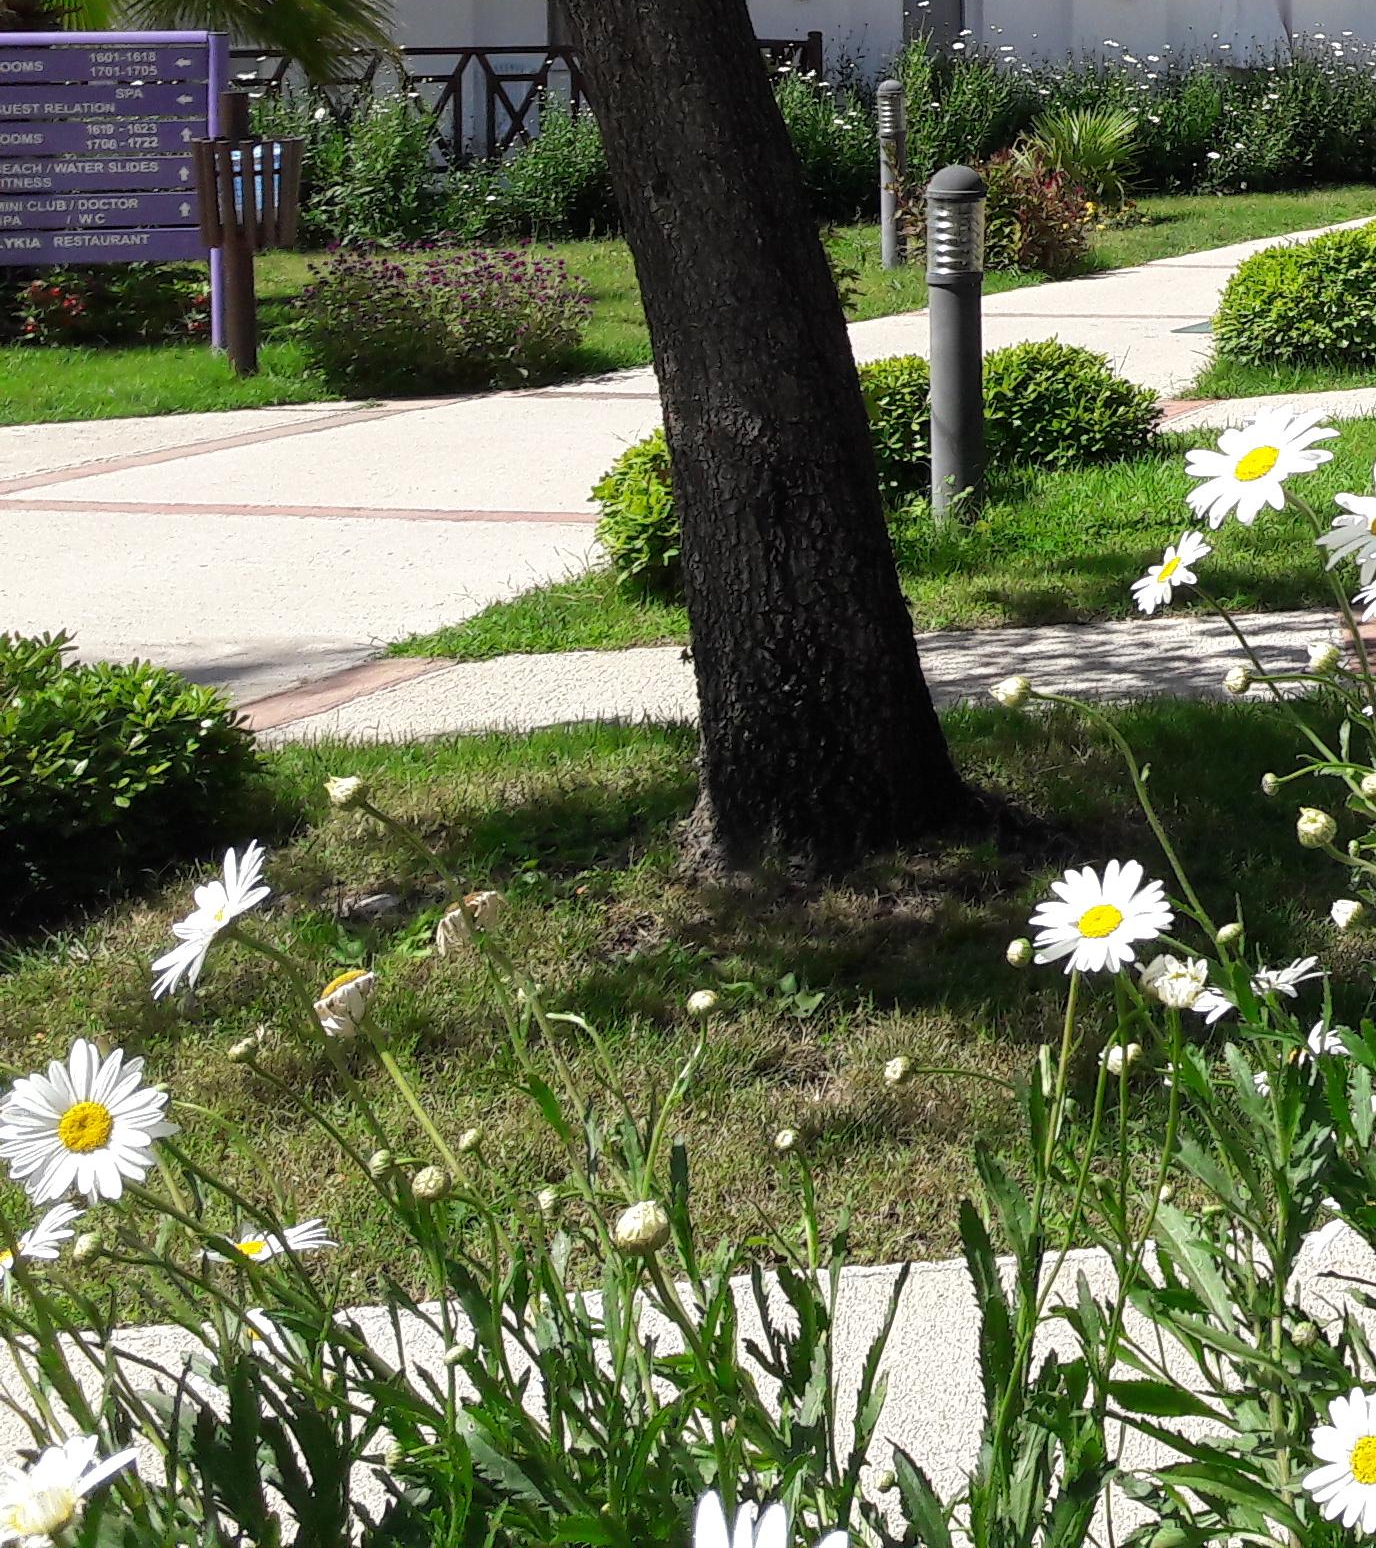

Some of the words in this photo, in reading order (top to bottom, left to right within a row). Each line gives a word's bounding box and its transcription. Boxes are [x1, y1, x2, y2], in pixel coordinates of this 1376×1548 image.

[0, 61, 44, 72] OOMS
[90, 65, 158, 77] 1701-1705
[115, 88, 144, 99] SPA
[0, 103, 40, 115] UEST
[44, 102, 116, 114] RELATION
[0, 133, 44, 144] OOMS
[0, 163, 42, 175] EACH
[54, 162, 104, 173] WATER
[108, 161, 159, 173] SLIDES
[0, 177, 52, 188] ITNESS
[27, 200, 67, 212] CLUB
[78, 198, 138, 210] DOCTOR
[0, 215, 21, 226] PA
[53, 234, 150, 248] RESTAURANT
